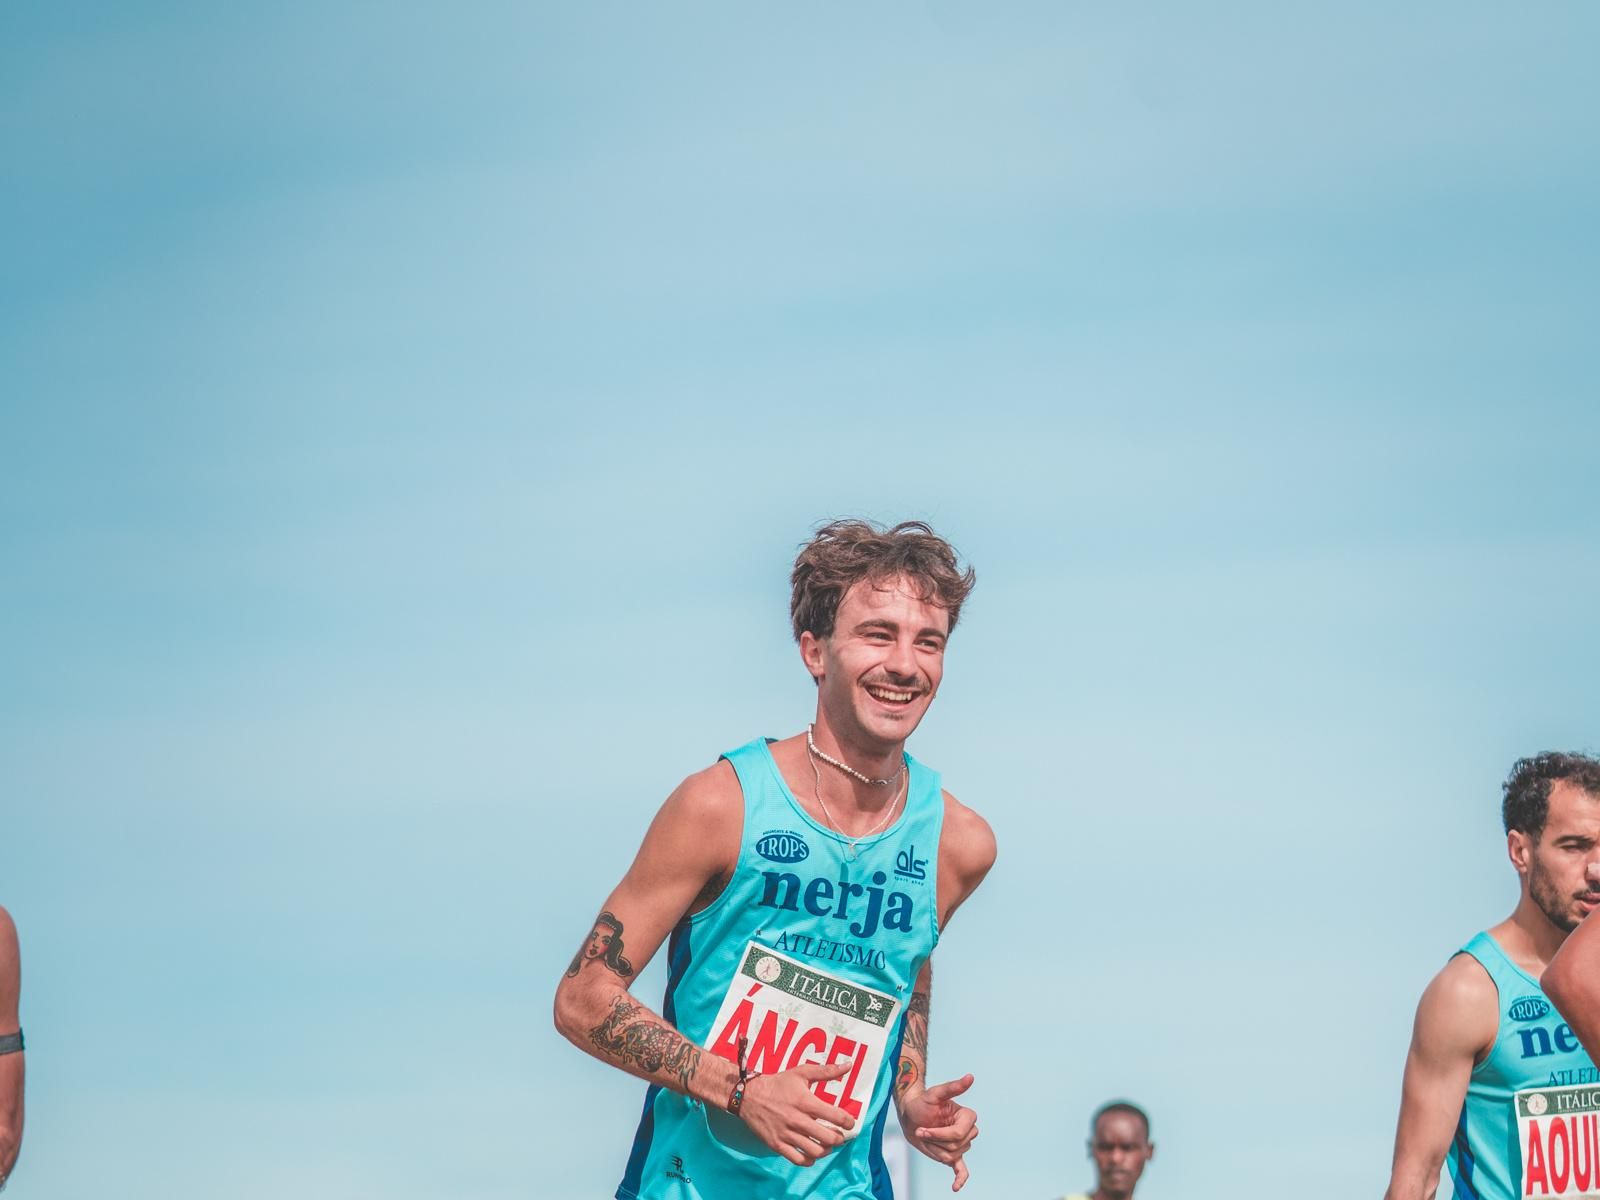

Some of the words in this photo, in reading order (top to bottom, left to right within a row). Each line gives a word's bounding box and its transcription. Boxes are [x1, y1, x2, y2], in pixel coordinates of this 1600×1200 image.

[759, 836, 807, 858] TROPS
[758, 871, 914, 938] nerja
[772, 931, 886, 970] ATLETISMO
[788, 972, 858, 1012] ITÁLICA
[1511, 1000, 1548, 1019] TROPS
[709, 982, 868, 1120] ÁNGEL
